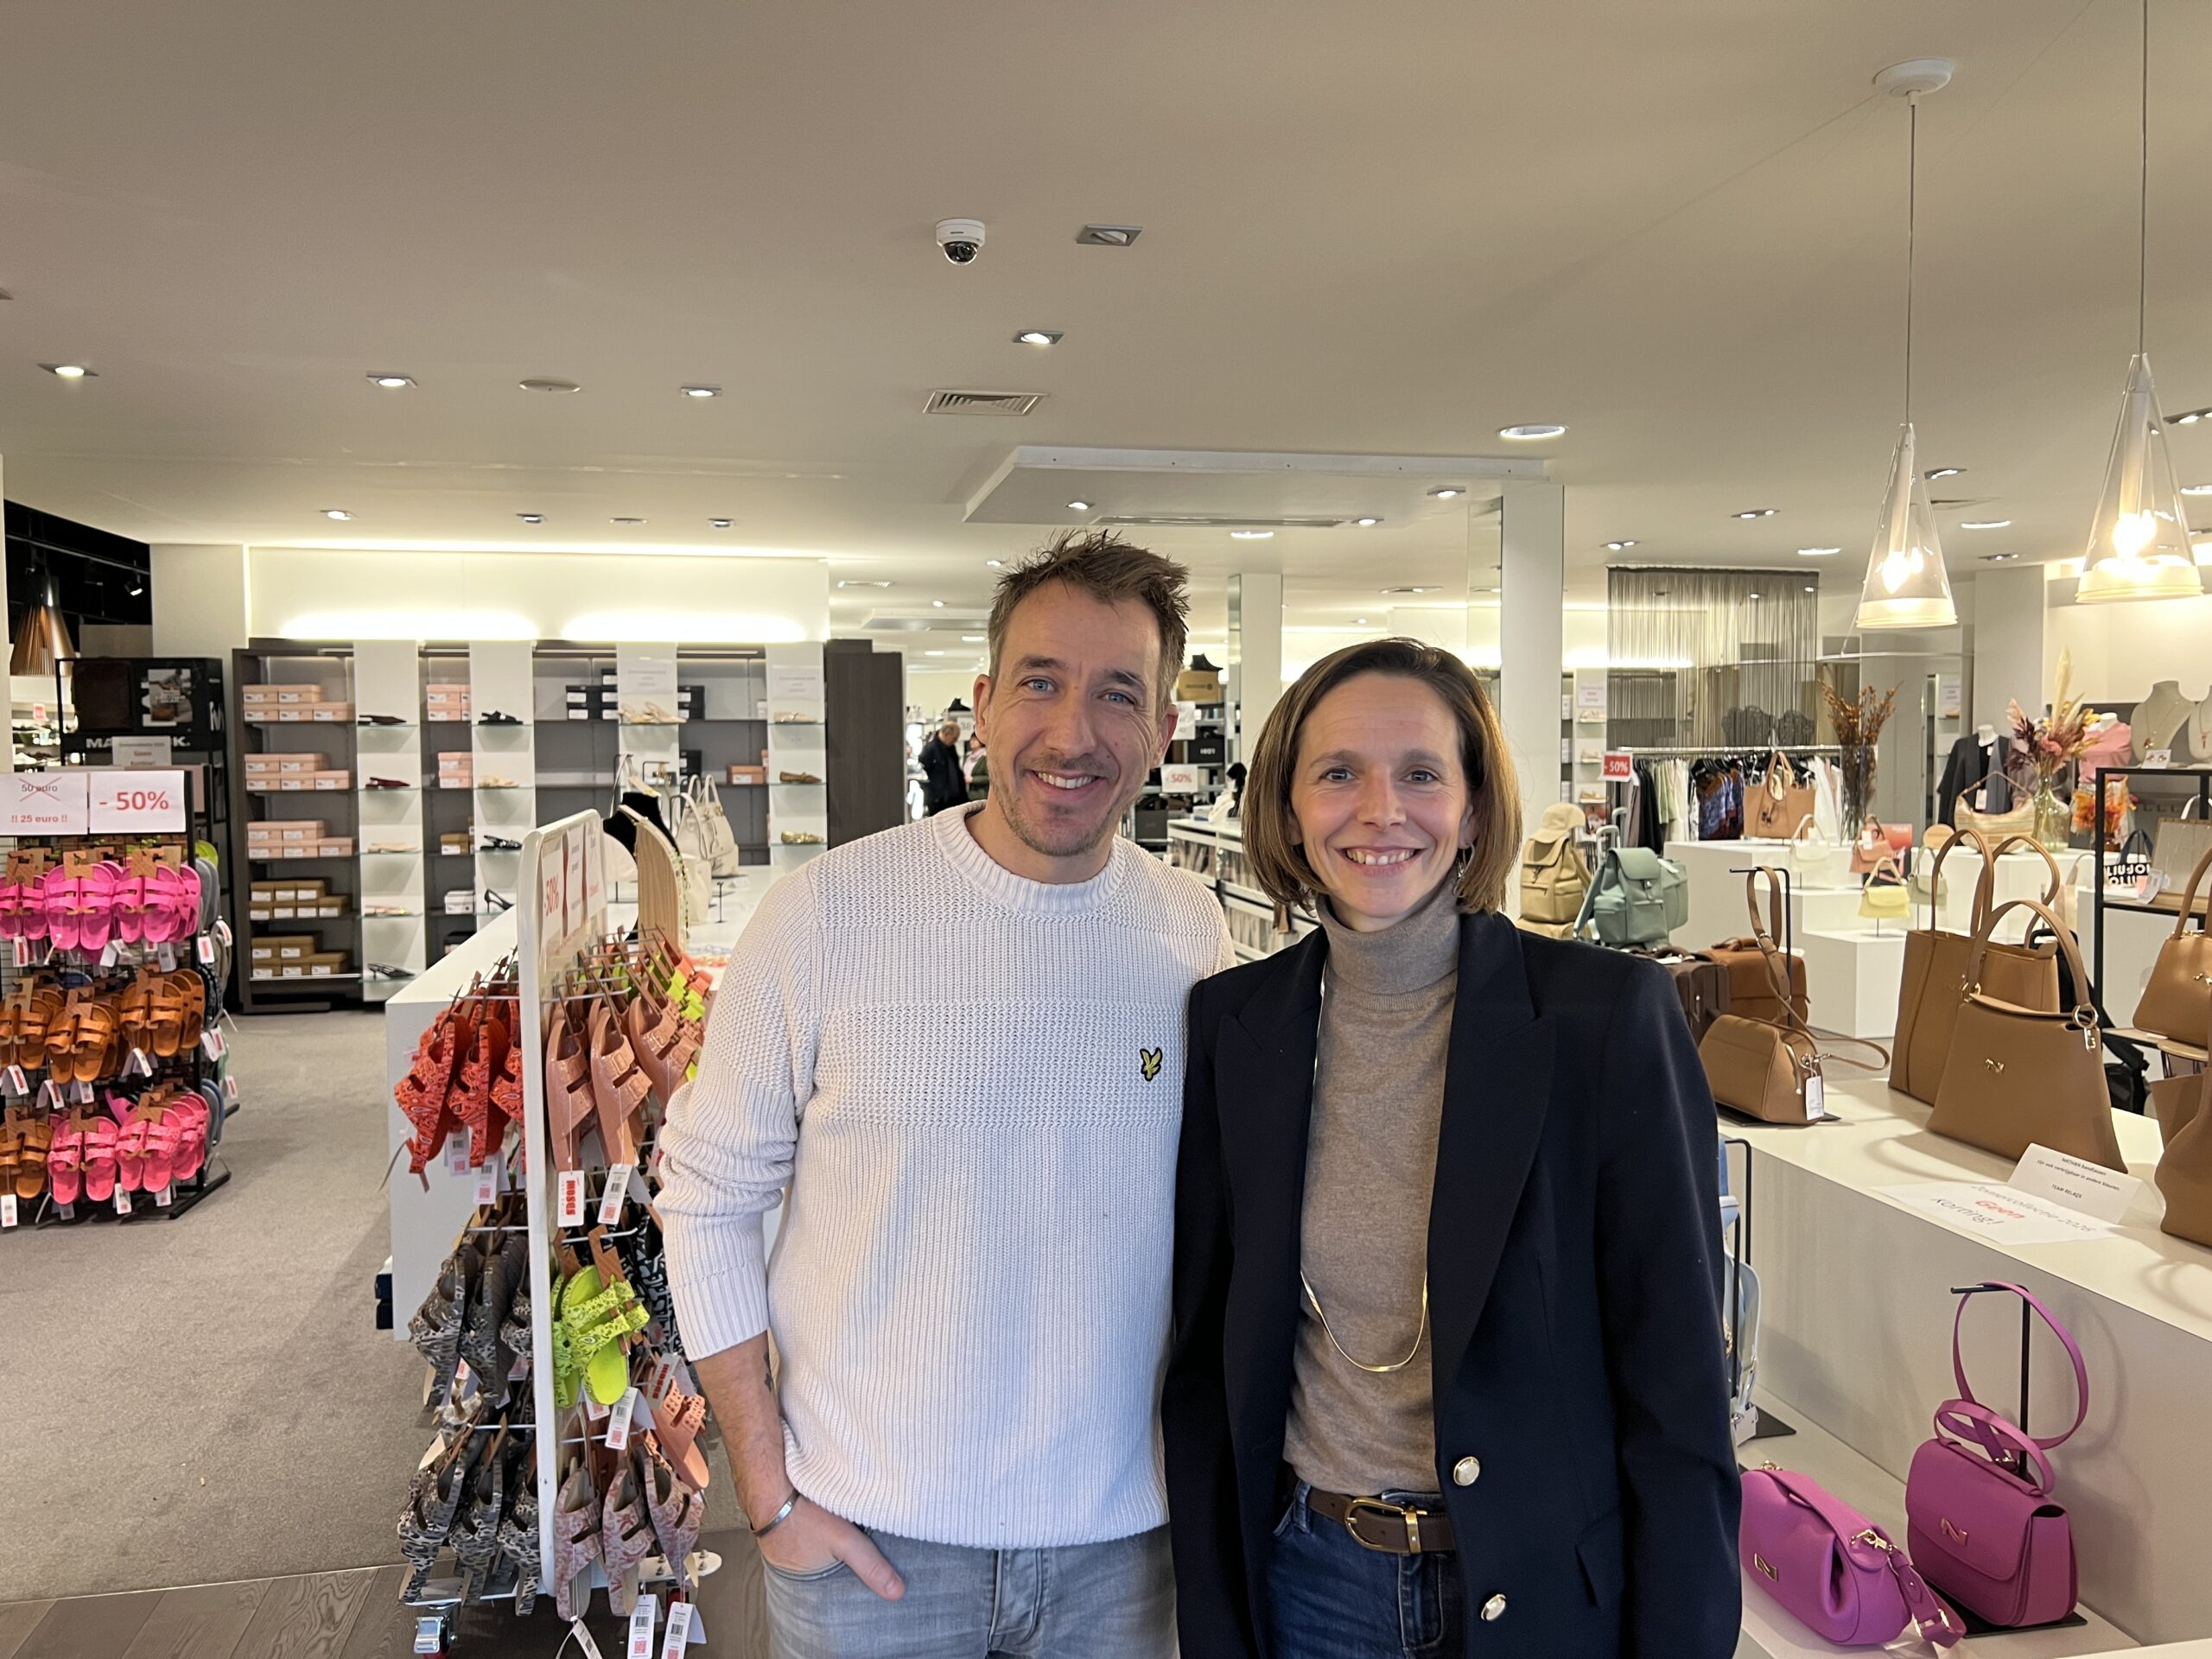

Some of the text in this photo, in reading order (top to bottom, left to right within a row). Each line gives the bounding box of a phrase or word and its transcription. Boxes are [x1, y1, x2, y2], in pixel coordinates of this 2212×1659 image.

[1609, 760, 1629, 773] 50%
[1171, 772, 1192, 784] 50%
[117, 791, 169, 810] 50%
[1975, 1200, 2025, 1219] Geen
